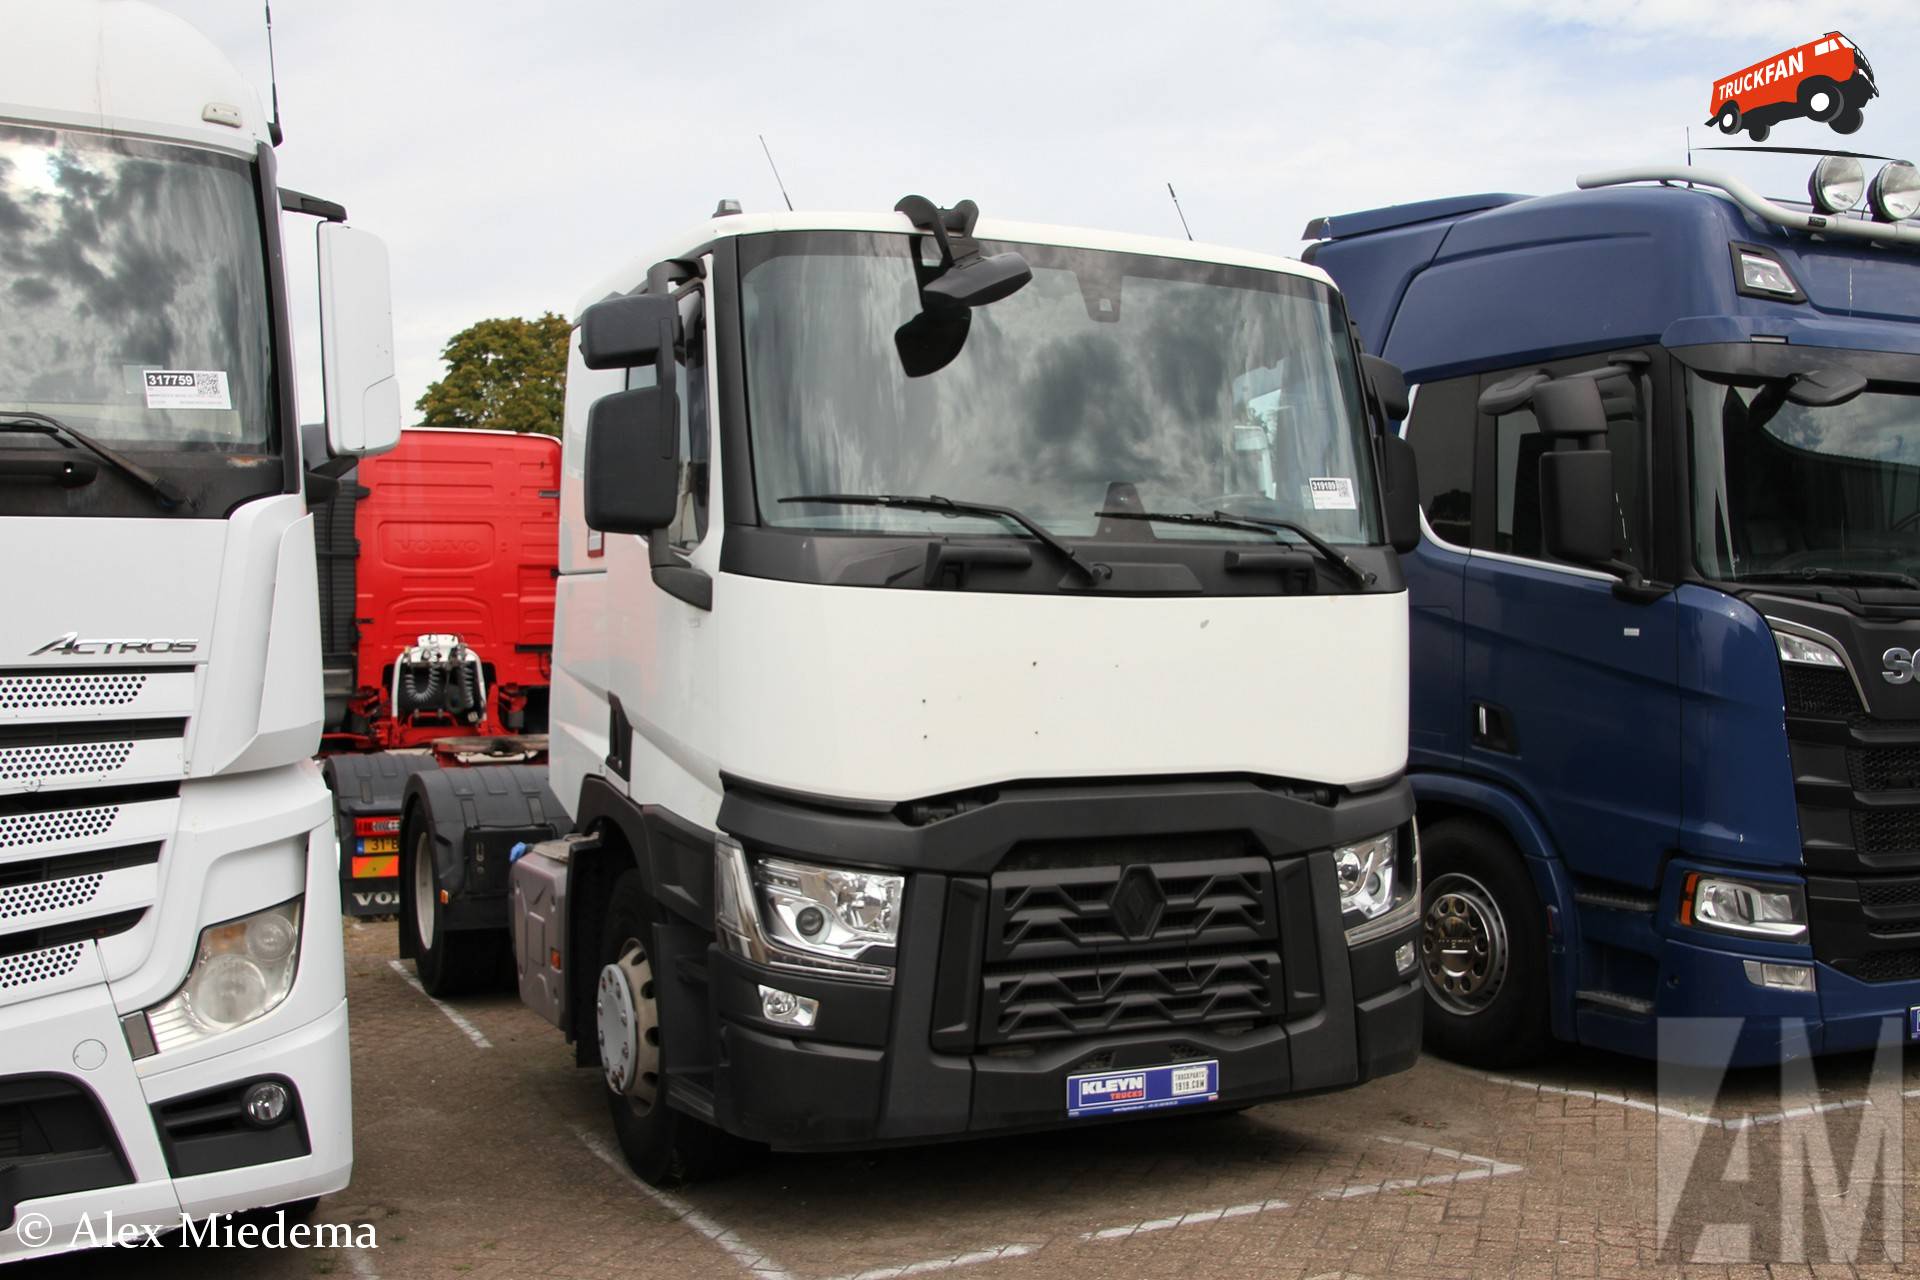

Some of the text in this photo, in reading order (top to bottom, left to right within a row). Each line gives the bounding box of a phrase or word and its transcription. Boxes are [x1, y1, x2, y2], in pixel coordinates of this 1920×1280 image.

[148, 375, 193, 386] 317759
[394, 539, 481, 553] VOLVO
[1082, 1076, 1143, 1095] KLEYN
[1110, 1090, 1143, 1100] TRUCKS
